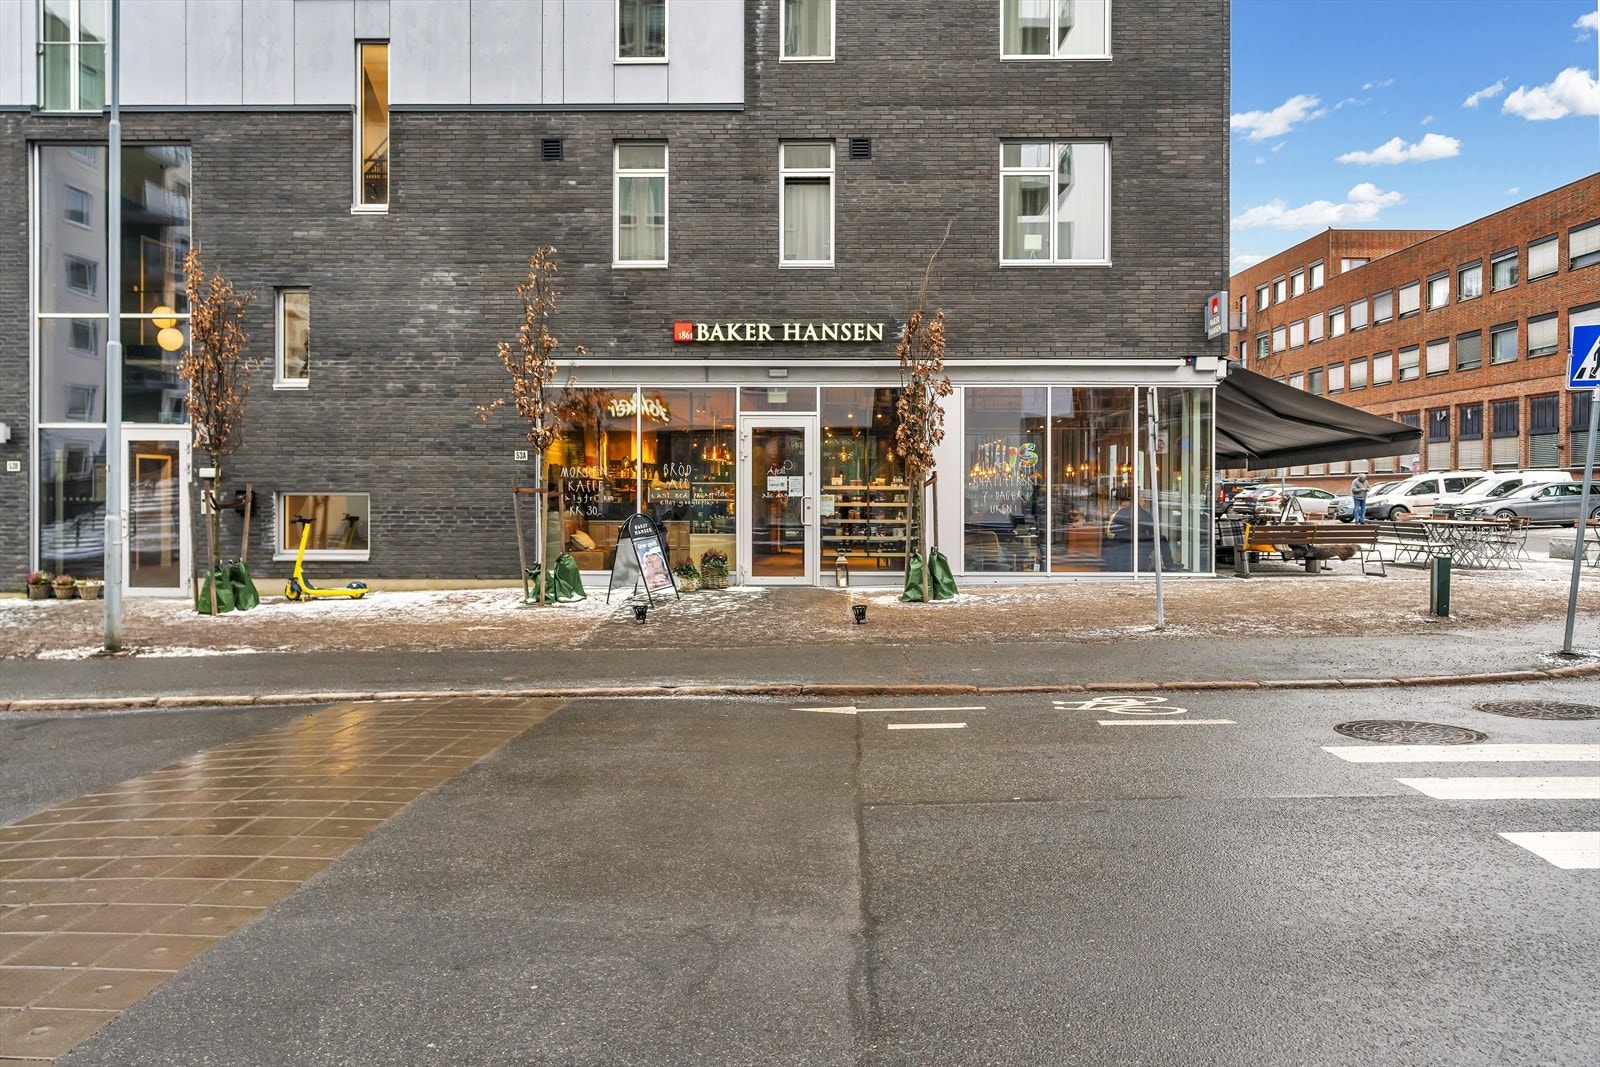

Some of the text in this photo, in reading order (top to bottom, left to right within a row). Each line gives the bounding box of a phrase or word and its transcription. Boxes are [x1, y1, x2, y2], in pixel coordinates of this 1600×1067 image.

[678, 323, 884, 341] 1861 BAKER HANSEN
[995, 490, 1023, 501] DAGER
[569, 505, 584, 516] KR
